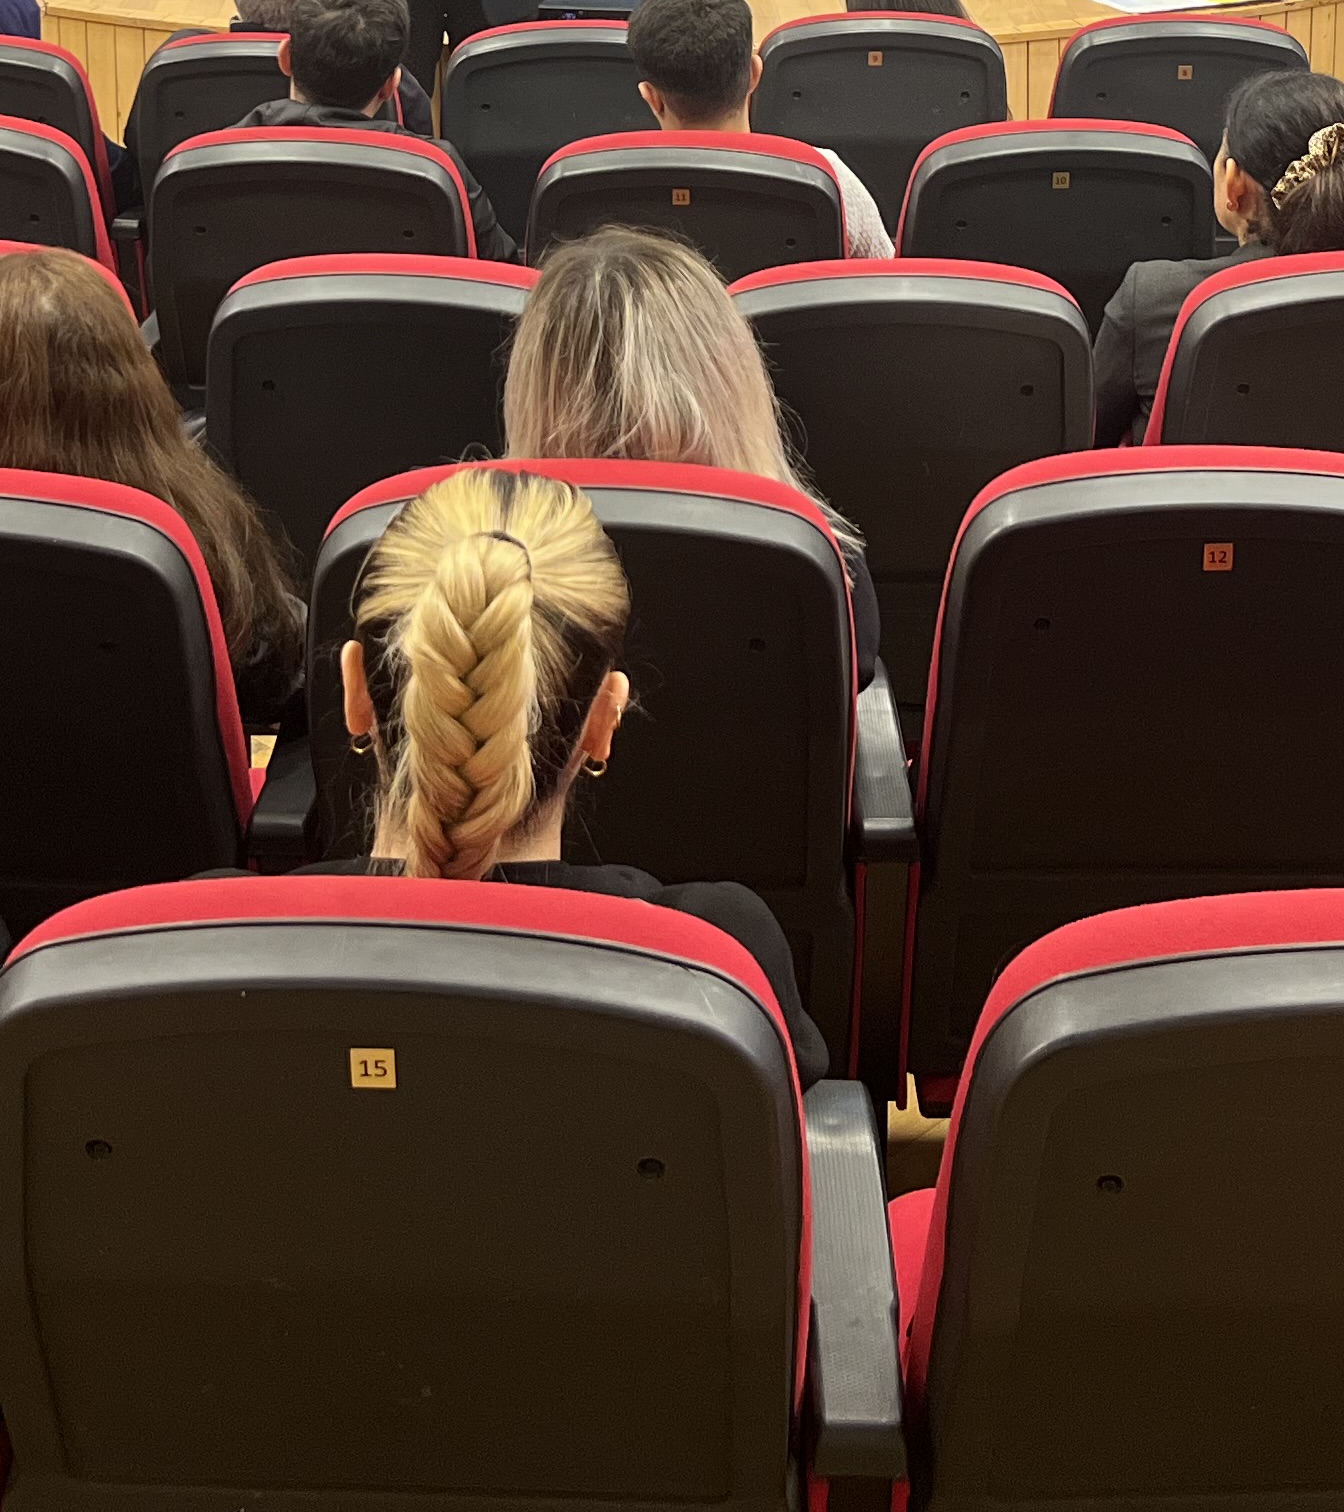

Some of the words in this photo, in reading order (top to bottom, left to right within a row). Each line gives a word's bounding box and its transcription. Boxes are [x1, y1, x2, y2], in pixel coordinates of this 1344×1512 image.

[1055, 177, 1066, 185] 10
[675, 193, 686, 201] 11
[1208, 551, 1227, 564] 12
[359, 1060, 388, 1077] 15
